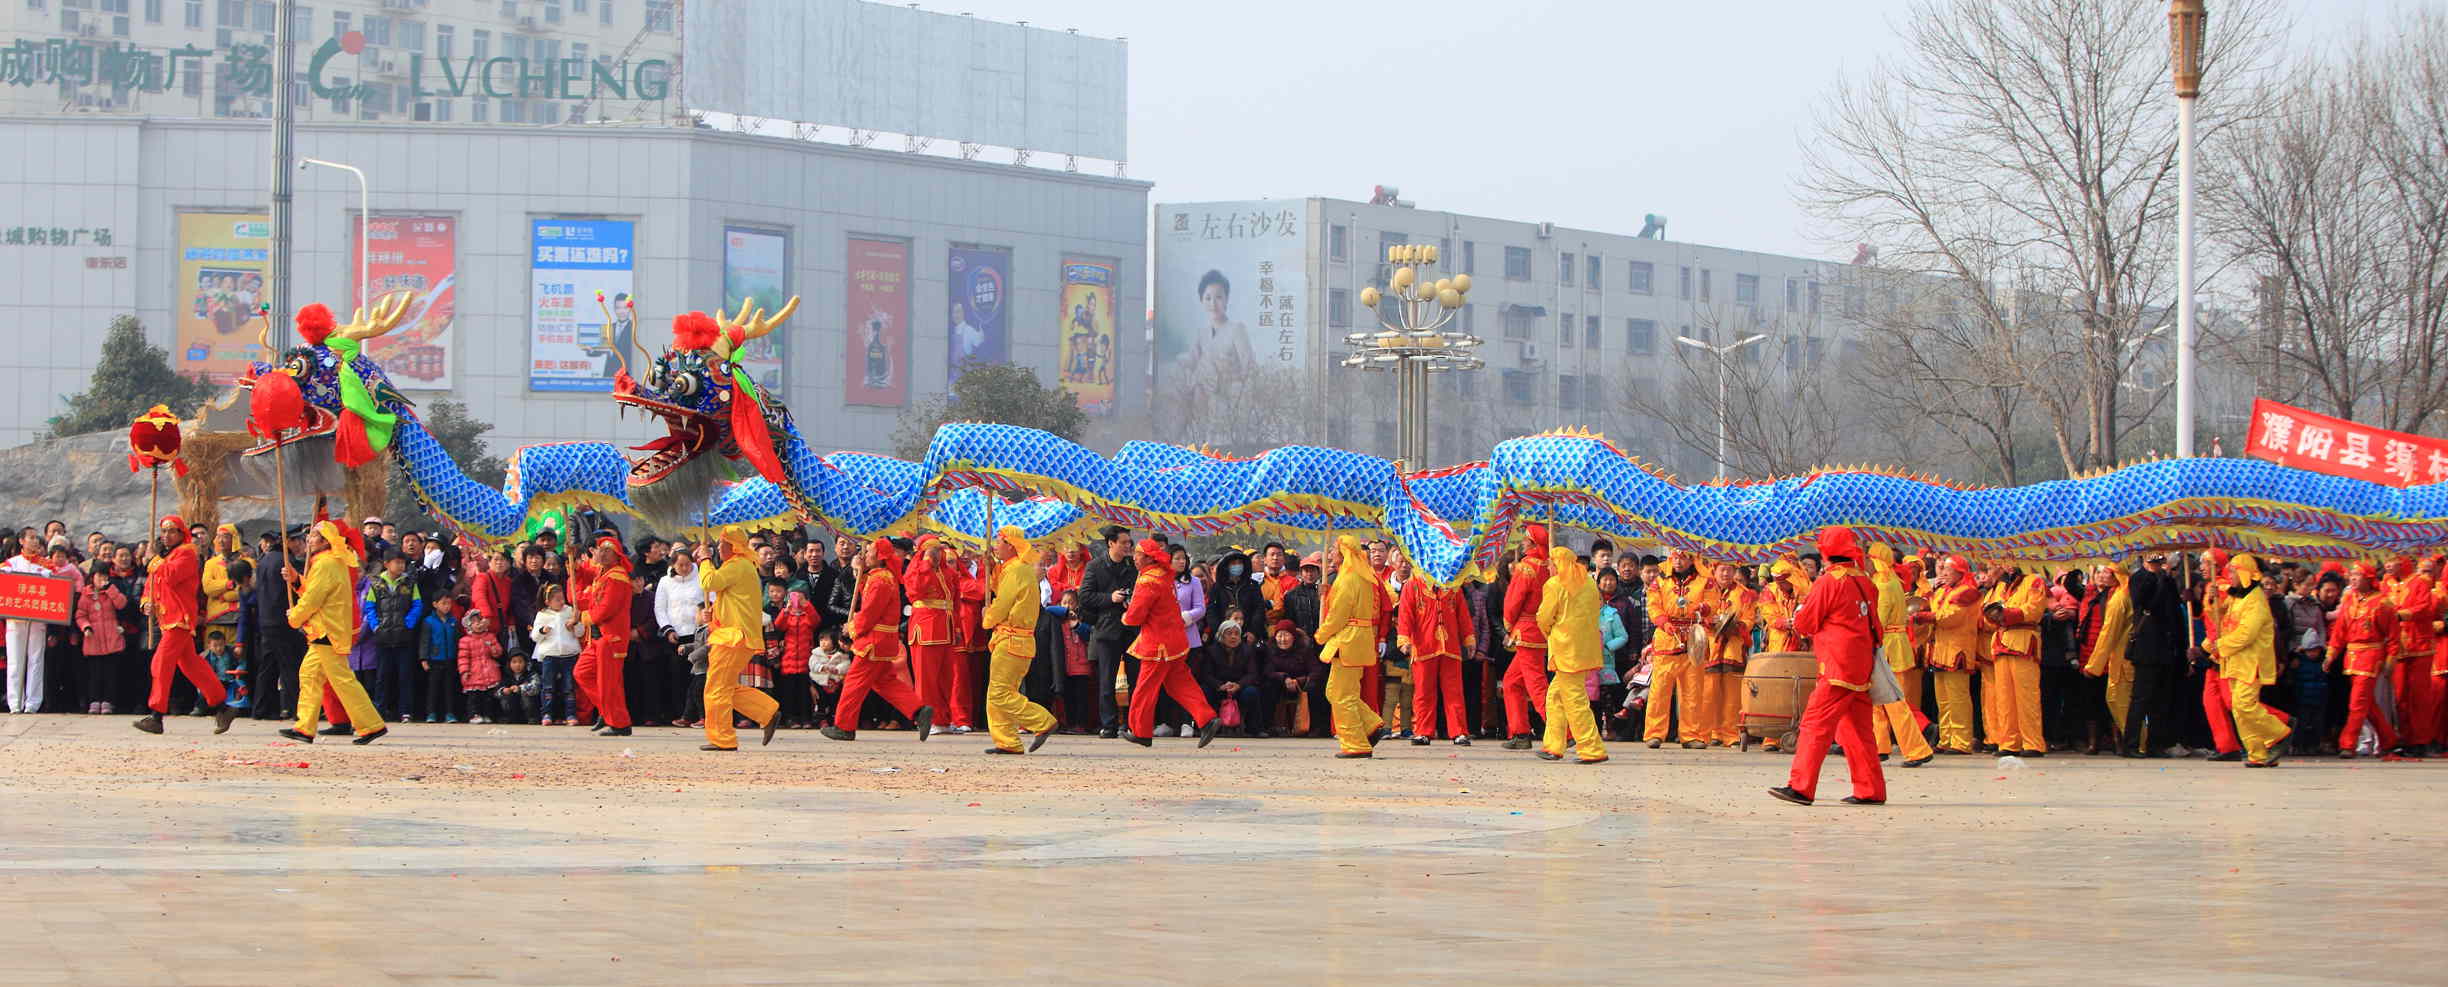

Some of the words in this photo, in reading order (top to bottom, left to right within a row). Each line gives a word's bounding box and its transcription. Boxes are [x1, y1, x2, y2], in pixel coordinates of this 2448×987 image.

[410, 52, 667, 101] LVCHENG
[0, 226, 112, 247] 城购物广场
[1200, 209, 1297, 240] 左右沙发
